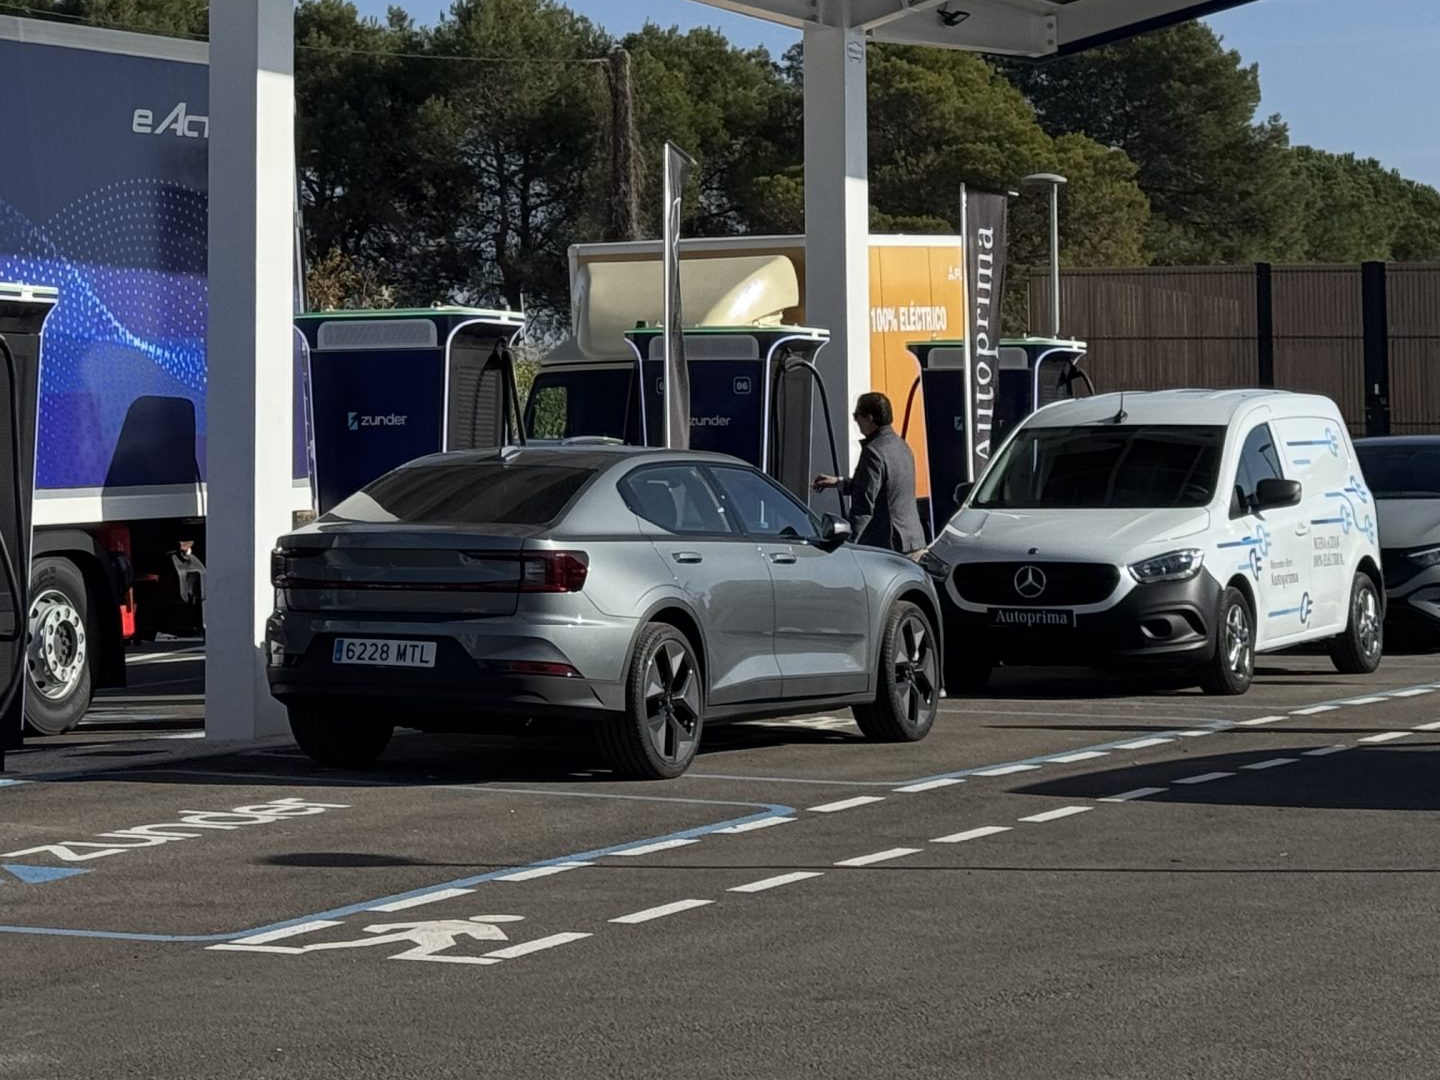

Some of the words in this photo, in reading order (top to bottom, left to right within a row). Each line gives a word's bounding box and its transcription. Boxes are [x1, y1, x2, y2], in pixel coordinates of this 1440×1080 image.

[870, 306, 899, 333] 100%
[899, 300, 948, 332] ELÉCTRICO
[360, 412, 407, 426] zunder
[689, 414, 731, 426] zunder
[995, 609, 1068, 627] Autoprima
[345, 642, 390, 661] 6228
[396, 643, 430, 664] MTL
[0, 797, 351, 861] zunder
